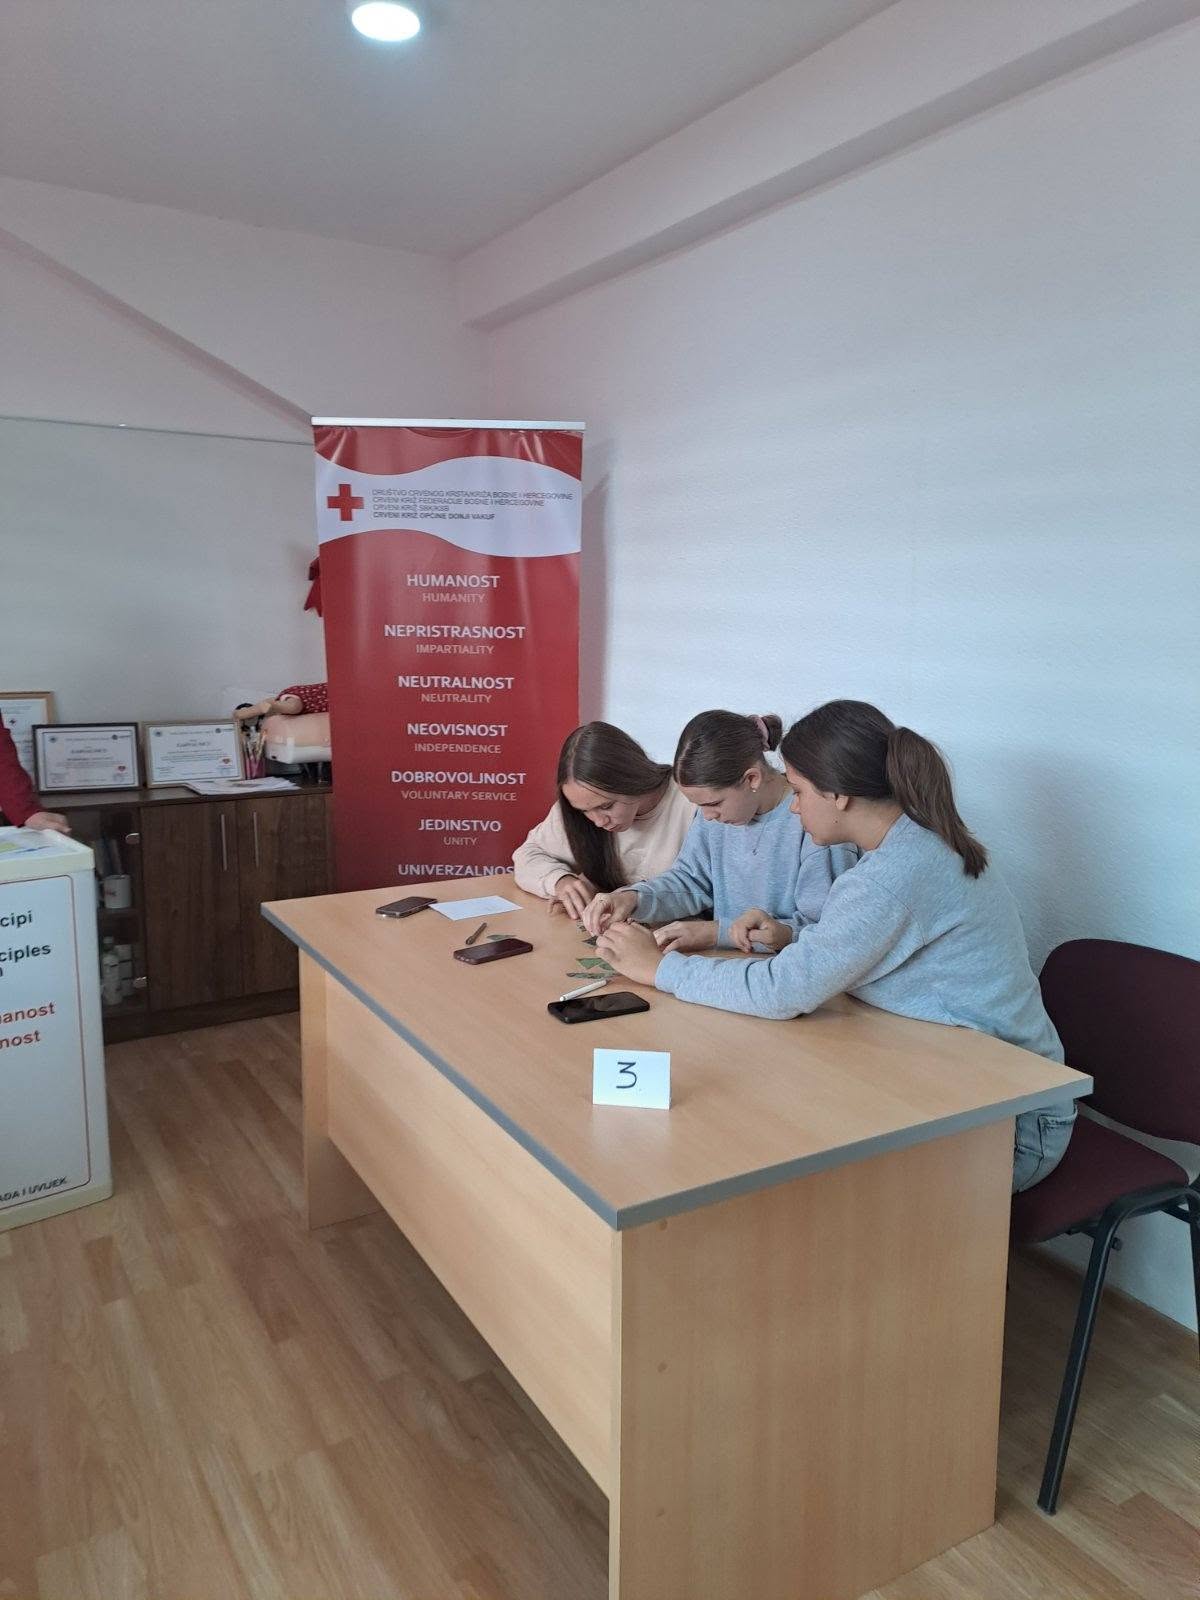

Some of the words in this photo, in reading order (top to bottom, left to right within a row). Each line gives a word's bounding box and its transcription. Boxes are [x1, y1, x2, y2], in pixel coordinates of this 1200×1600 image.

[408, 489, 445, 497] CRVENOG
[492, 491, 518, 499] BOSNE
[523, 491, 574, 501] HERCEGOVINE
[372, 496, 400, 504] CRVENI
[419, 497, 463, 505] FEDERACIJE
[464, 498, 490, 506] BOSNE
[494, 498, 545, 507] HERCEGOVINE
[373, 511, 400, 519] CRVENI
[448, 512, 470, 520] DONJI
[471, 513, 496, 521] VAKUF
[406, 574, 500, 588] HUMANOST
[422, 592, 486, 603] HUMANITY
[384, 624, 526, 639] NEPRISTRASNOST
[416, 644, 495, 655] IMPARTIALITY
[398, 675, 515, 690] NEUTRALNOST
[421, 693, 492, 704] NEUTRALITY
[407, 723, 508, 737] NEOVISNOST
[414, 743, 502, 754] INDEPENDENCE
[391, 770, 527, 785] DOBROVOLJNOST
[401, 790, 470, 801] VOLUNTARY
[471, 791, 517, 802] SERVICE
[418, 818, 502, 832] JEDINSTVO
[443, 836, 478, 846] UNITY
[398, 863, 515, 876] UNIVERZALNOS
[0, 1002, 56, 1025] anost
[615, 1061, 638, 1089] 3
